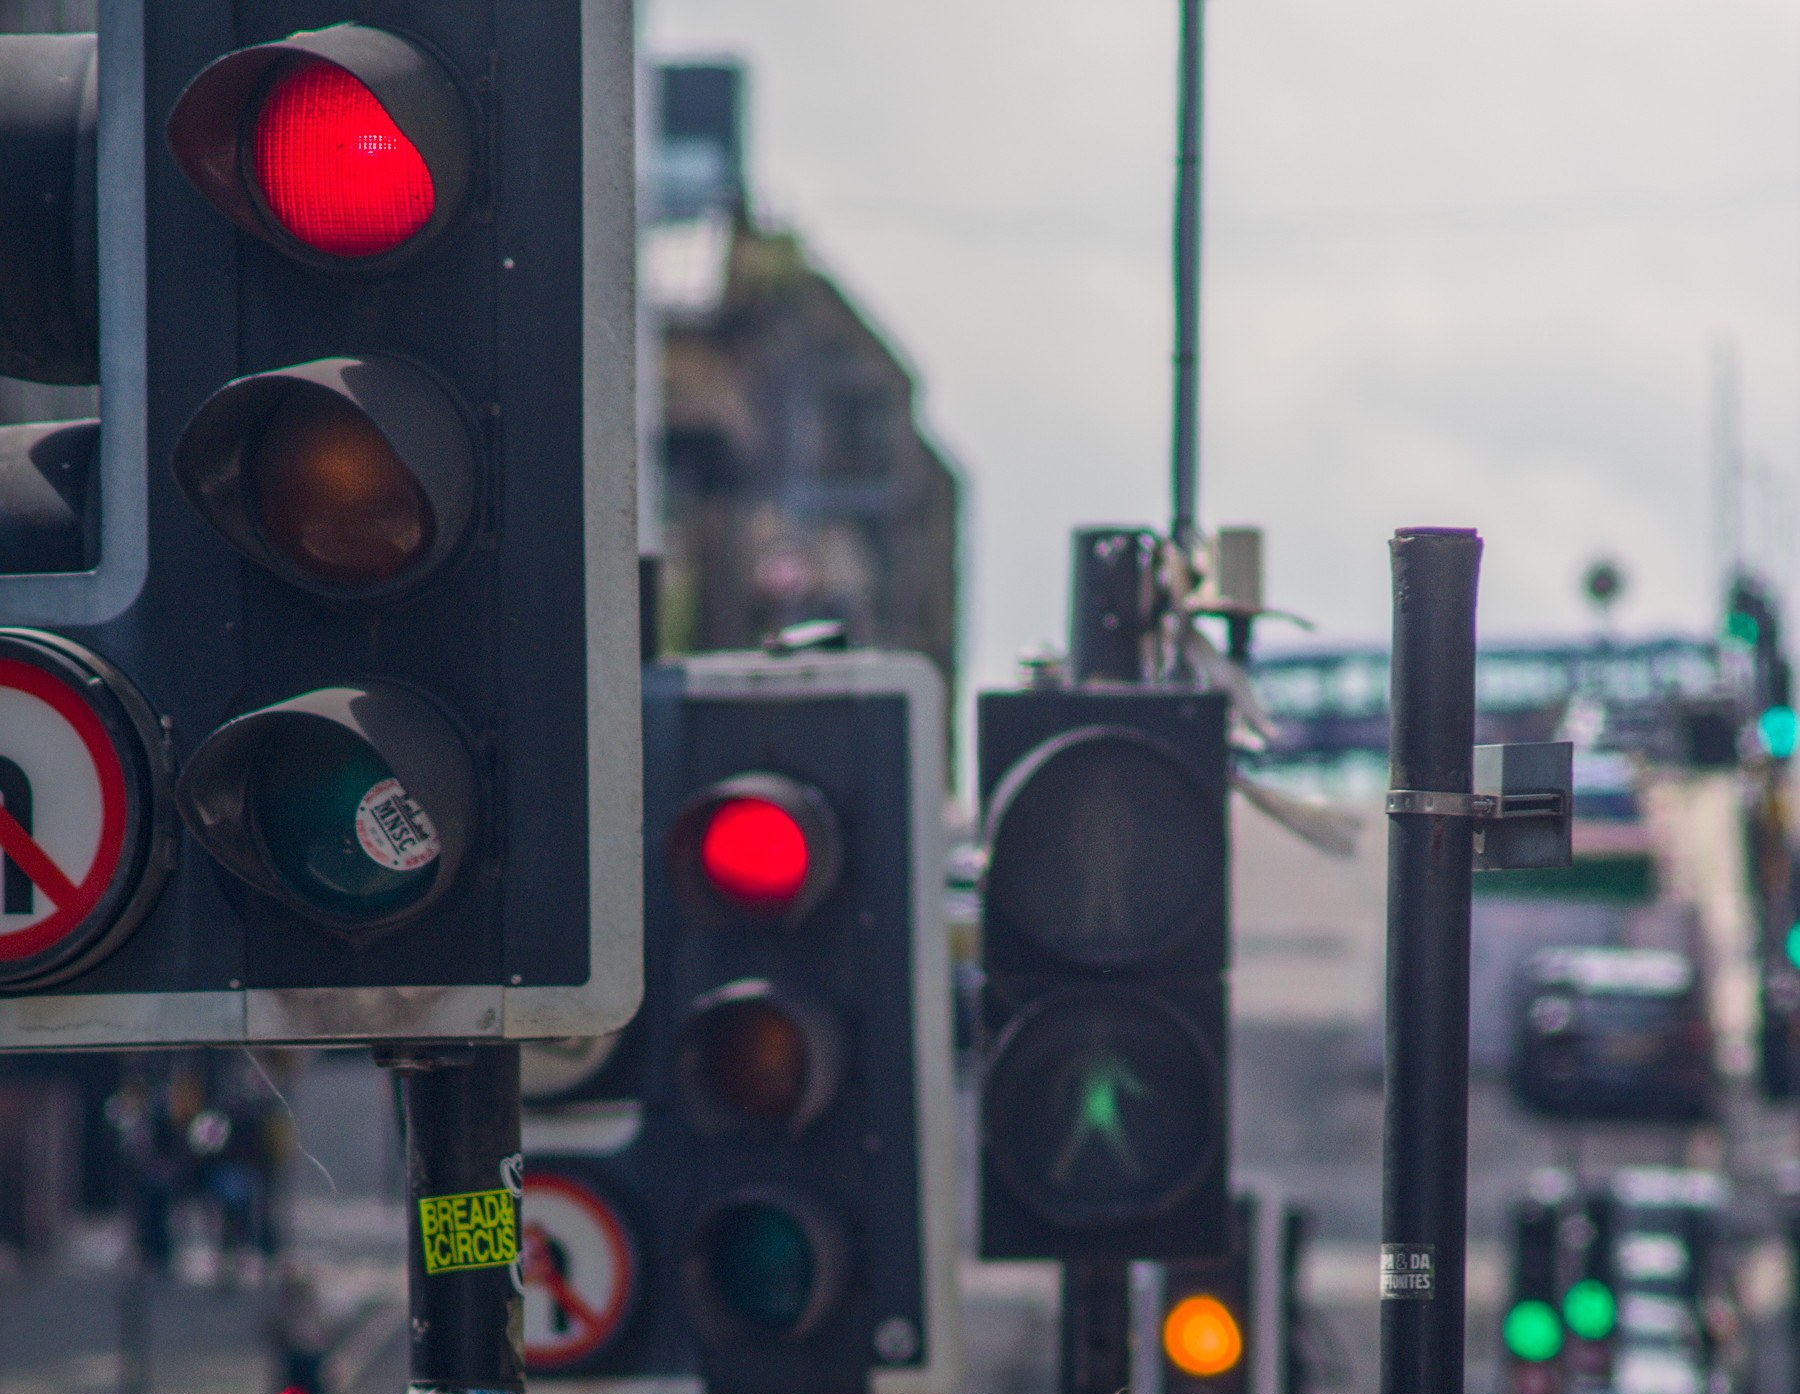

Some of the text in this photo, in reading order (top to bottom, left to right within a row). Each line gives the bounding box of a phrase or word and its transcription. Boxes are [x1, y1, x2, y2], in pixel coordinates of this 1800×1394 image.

[374, 799, 416, 852] MNSC
[434, 1226, 515, 1266] CIRCUS
[1410, 1254, 1430, 1269] DA
